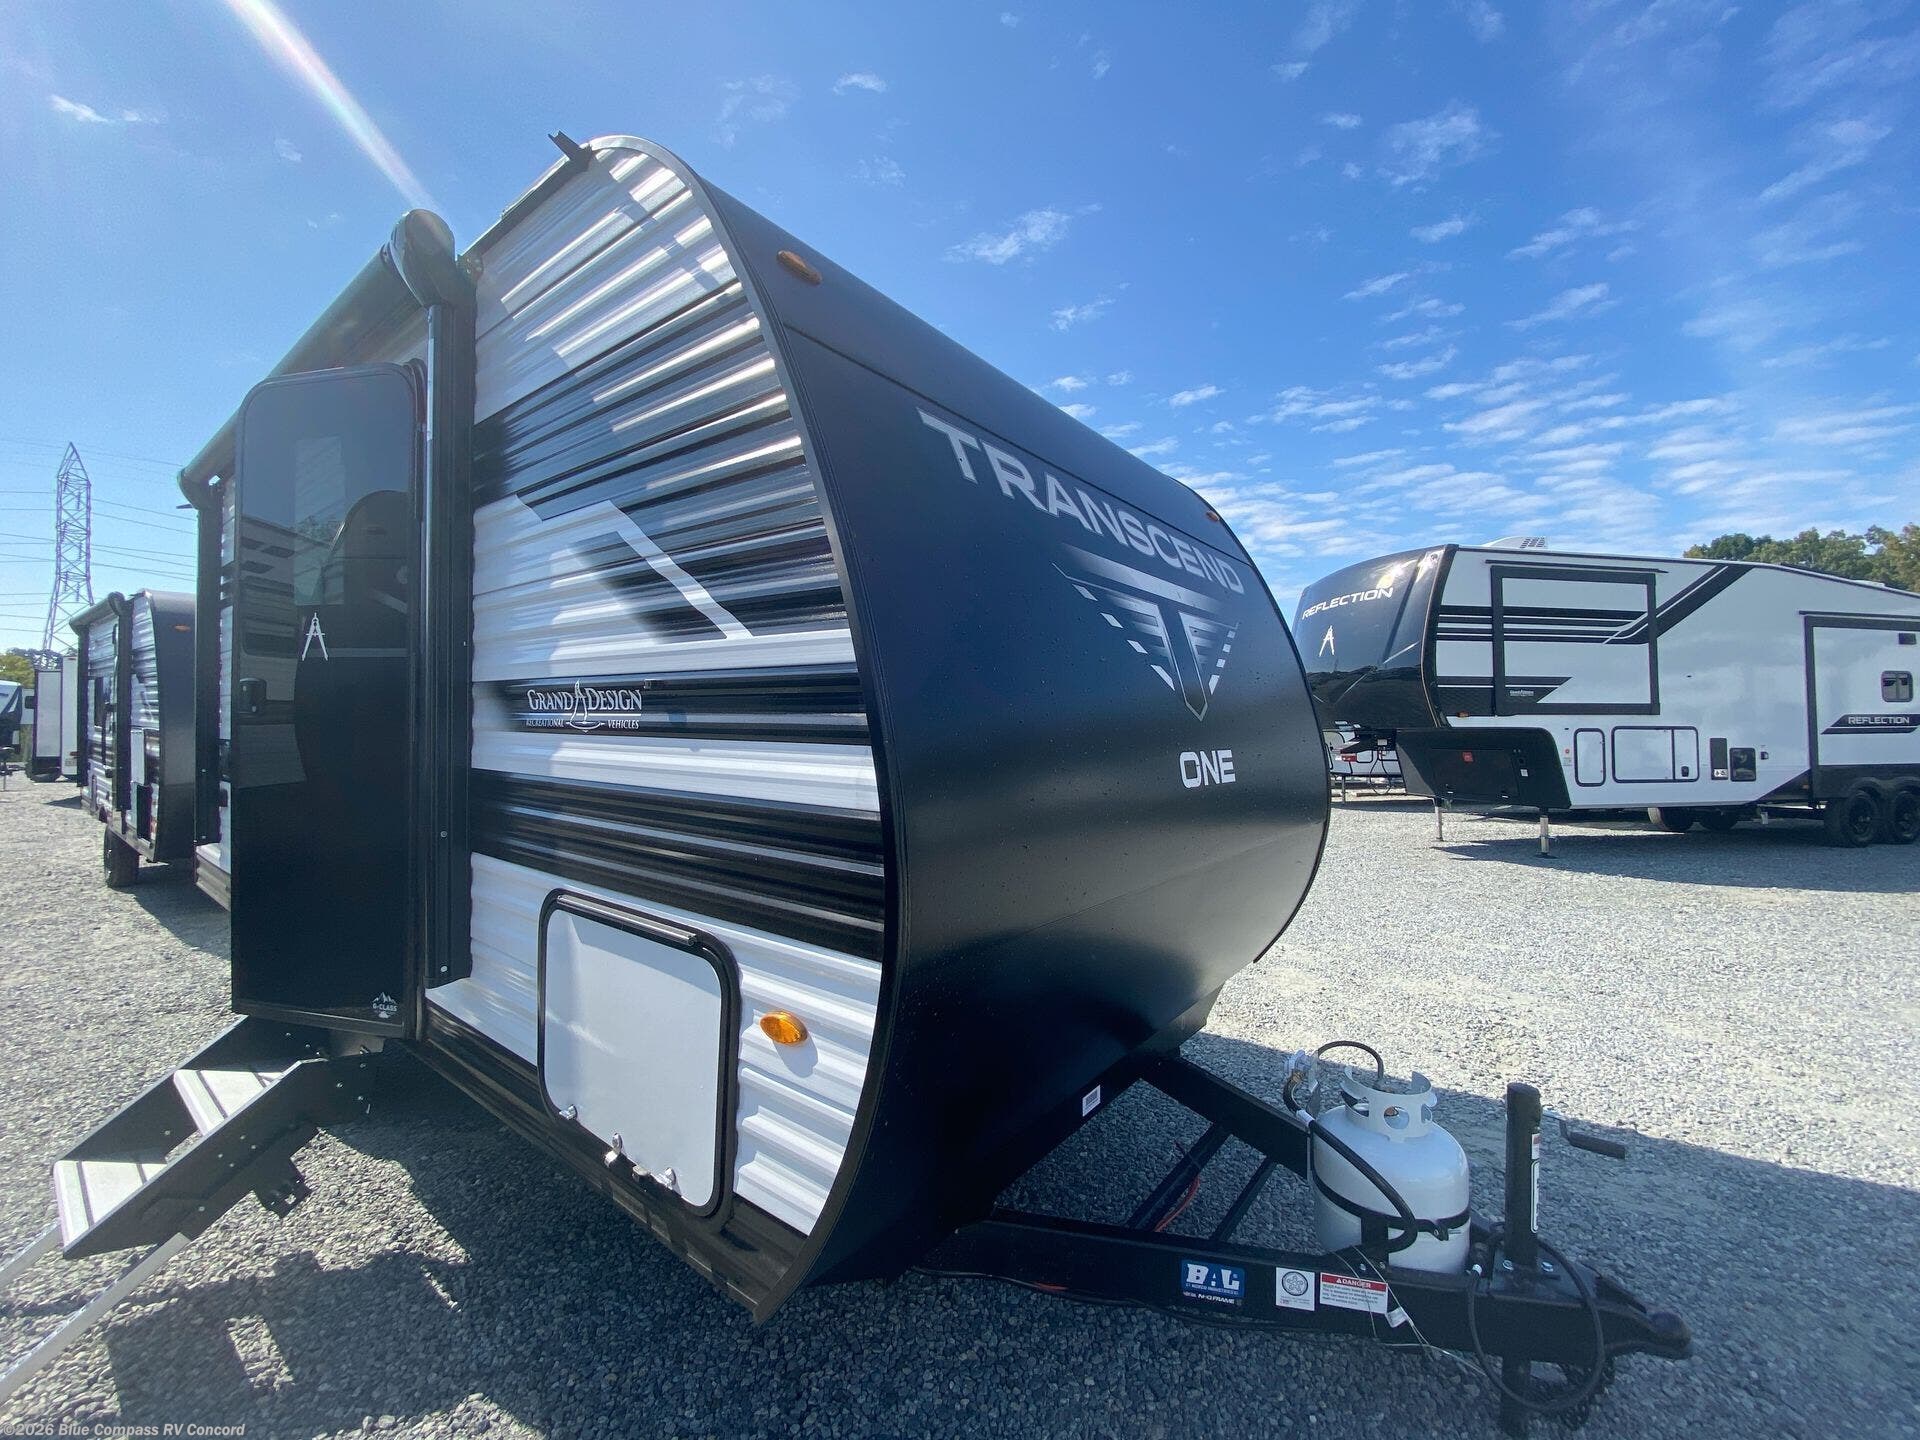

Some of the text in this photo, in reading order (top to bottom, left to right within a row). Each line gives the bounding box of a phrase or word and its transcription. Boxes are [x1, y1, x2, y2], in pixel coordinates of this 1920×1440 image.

[916, 407, 1245, 595] TRANSCEND
[1301, 587, 1393, 620] REFLECTION
[526, 688, 642, 711] GRAND DESIGN
[608, 719, 640, 729] VEHICLES
[1848, 716, 1910, 724] REFLECTION
[1179, 749, 1236, 789] ONE
[1186, 1263, 1240, 1291] BAL
[1342, 1279, 1371, 1288] DANGER
